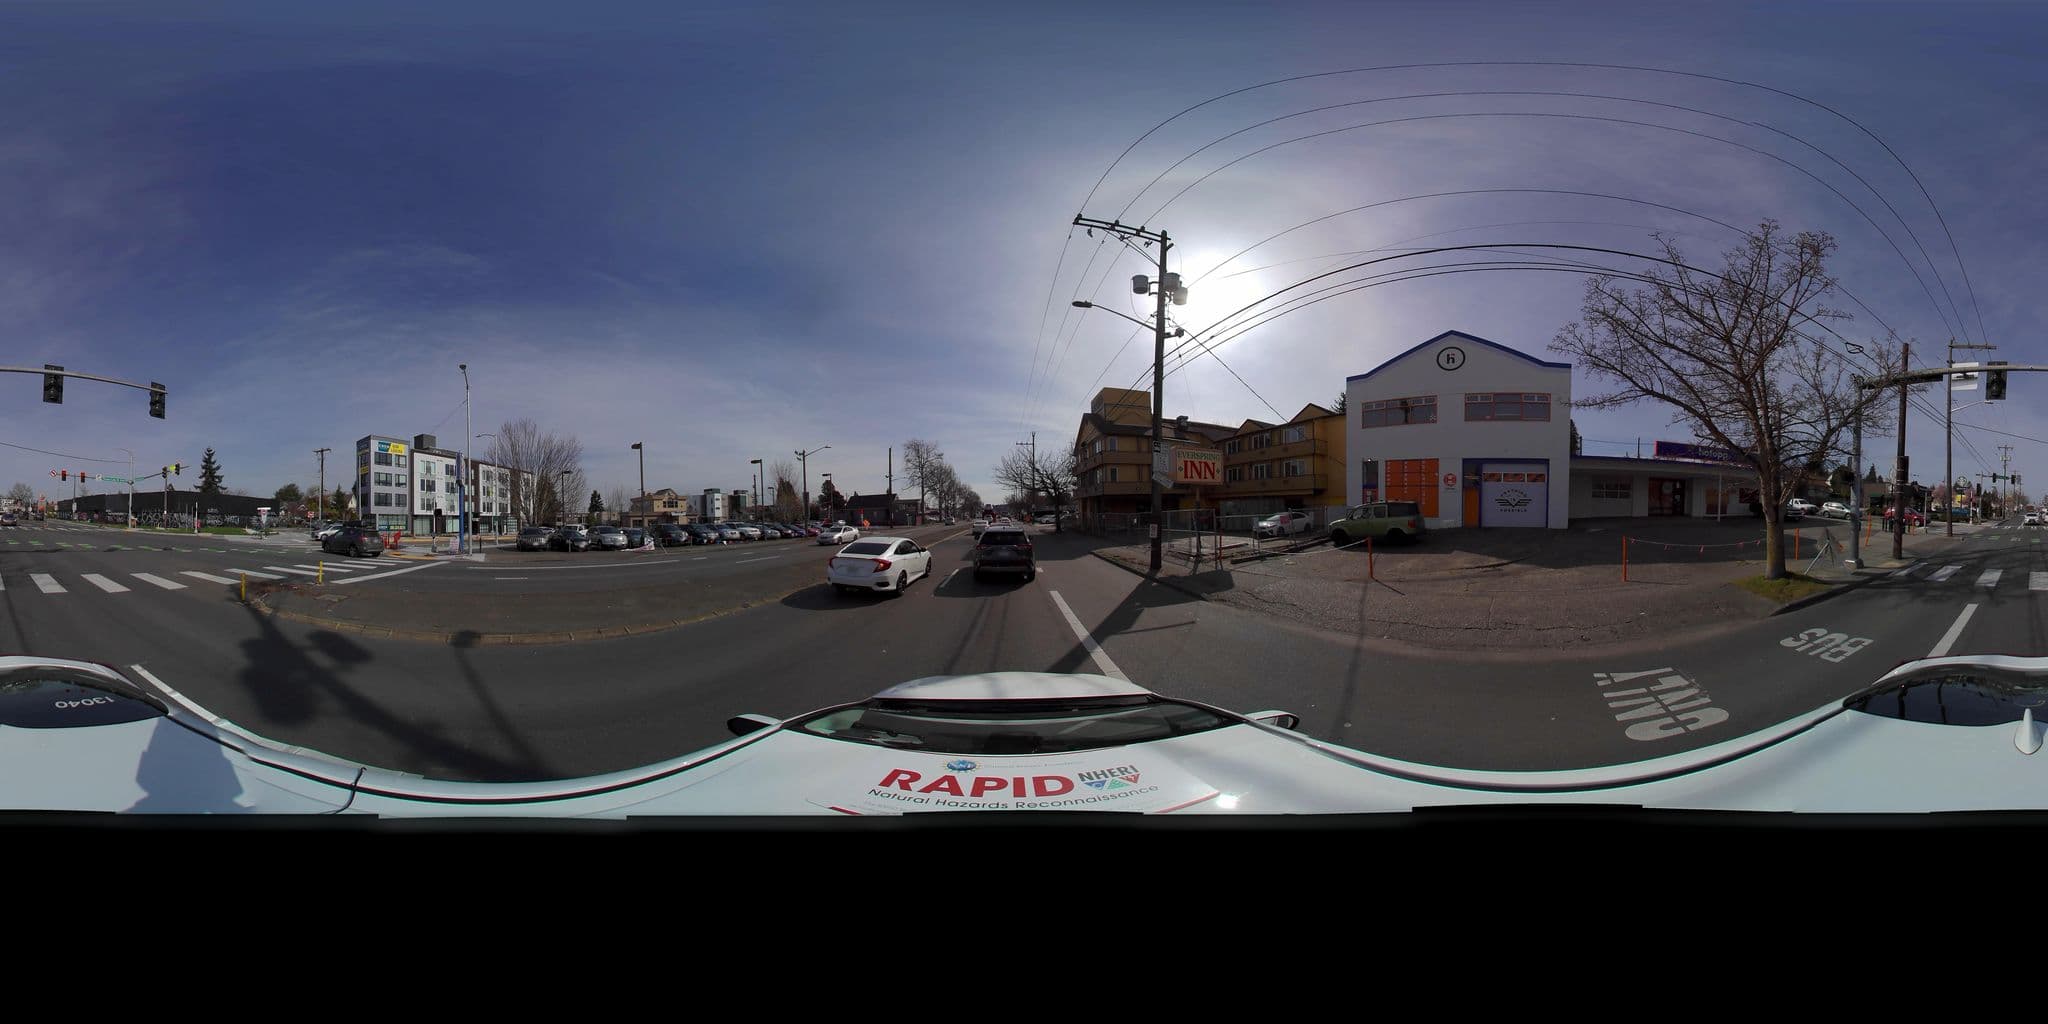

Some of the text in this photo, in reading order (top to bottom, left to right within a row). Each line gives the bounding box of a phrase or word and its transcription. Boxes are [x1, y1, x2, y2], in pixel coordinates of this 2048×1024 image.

[1177, 451, 1220, 460] EVERSPRING
[1183, 460, 1215, 480] INN
[1780, 628, 1873, 663] BUS
[55, 696, 114, 708] 13040
[1593, 667, 1730, 741] ONLY
[878, 769, 1075, 798] RAPID
[1078, 765, 1139, 782] NHERI
[868, 785, 1159, 809] Natural Hazards Reconnaissance
